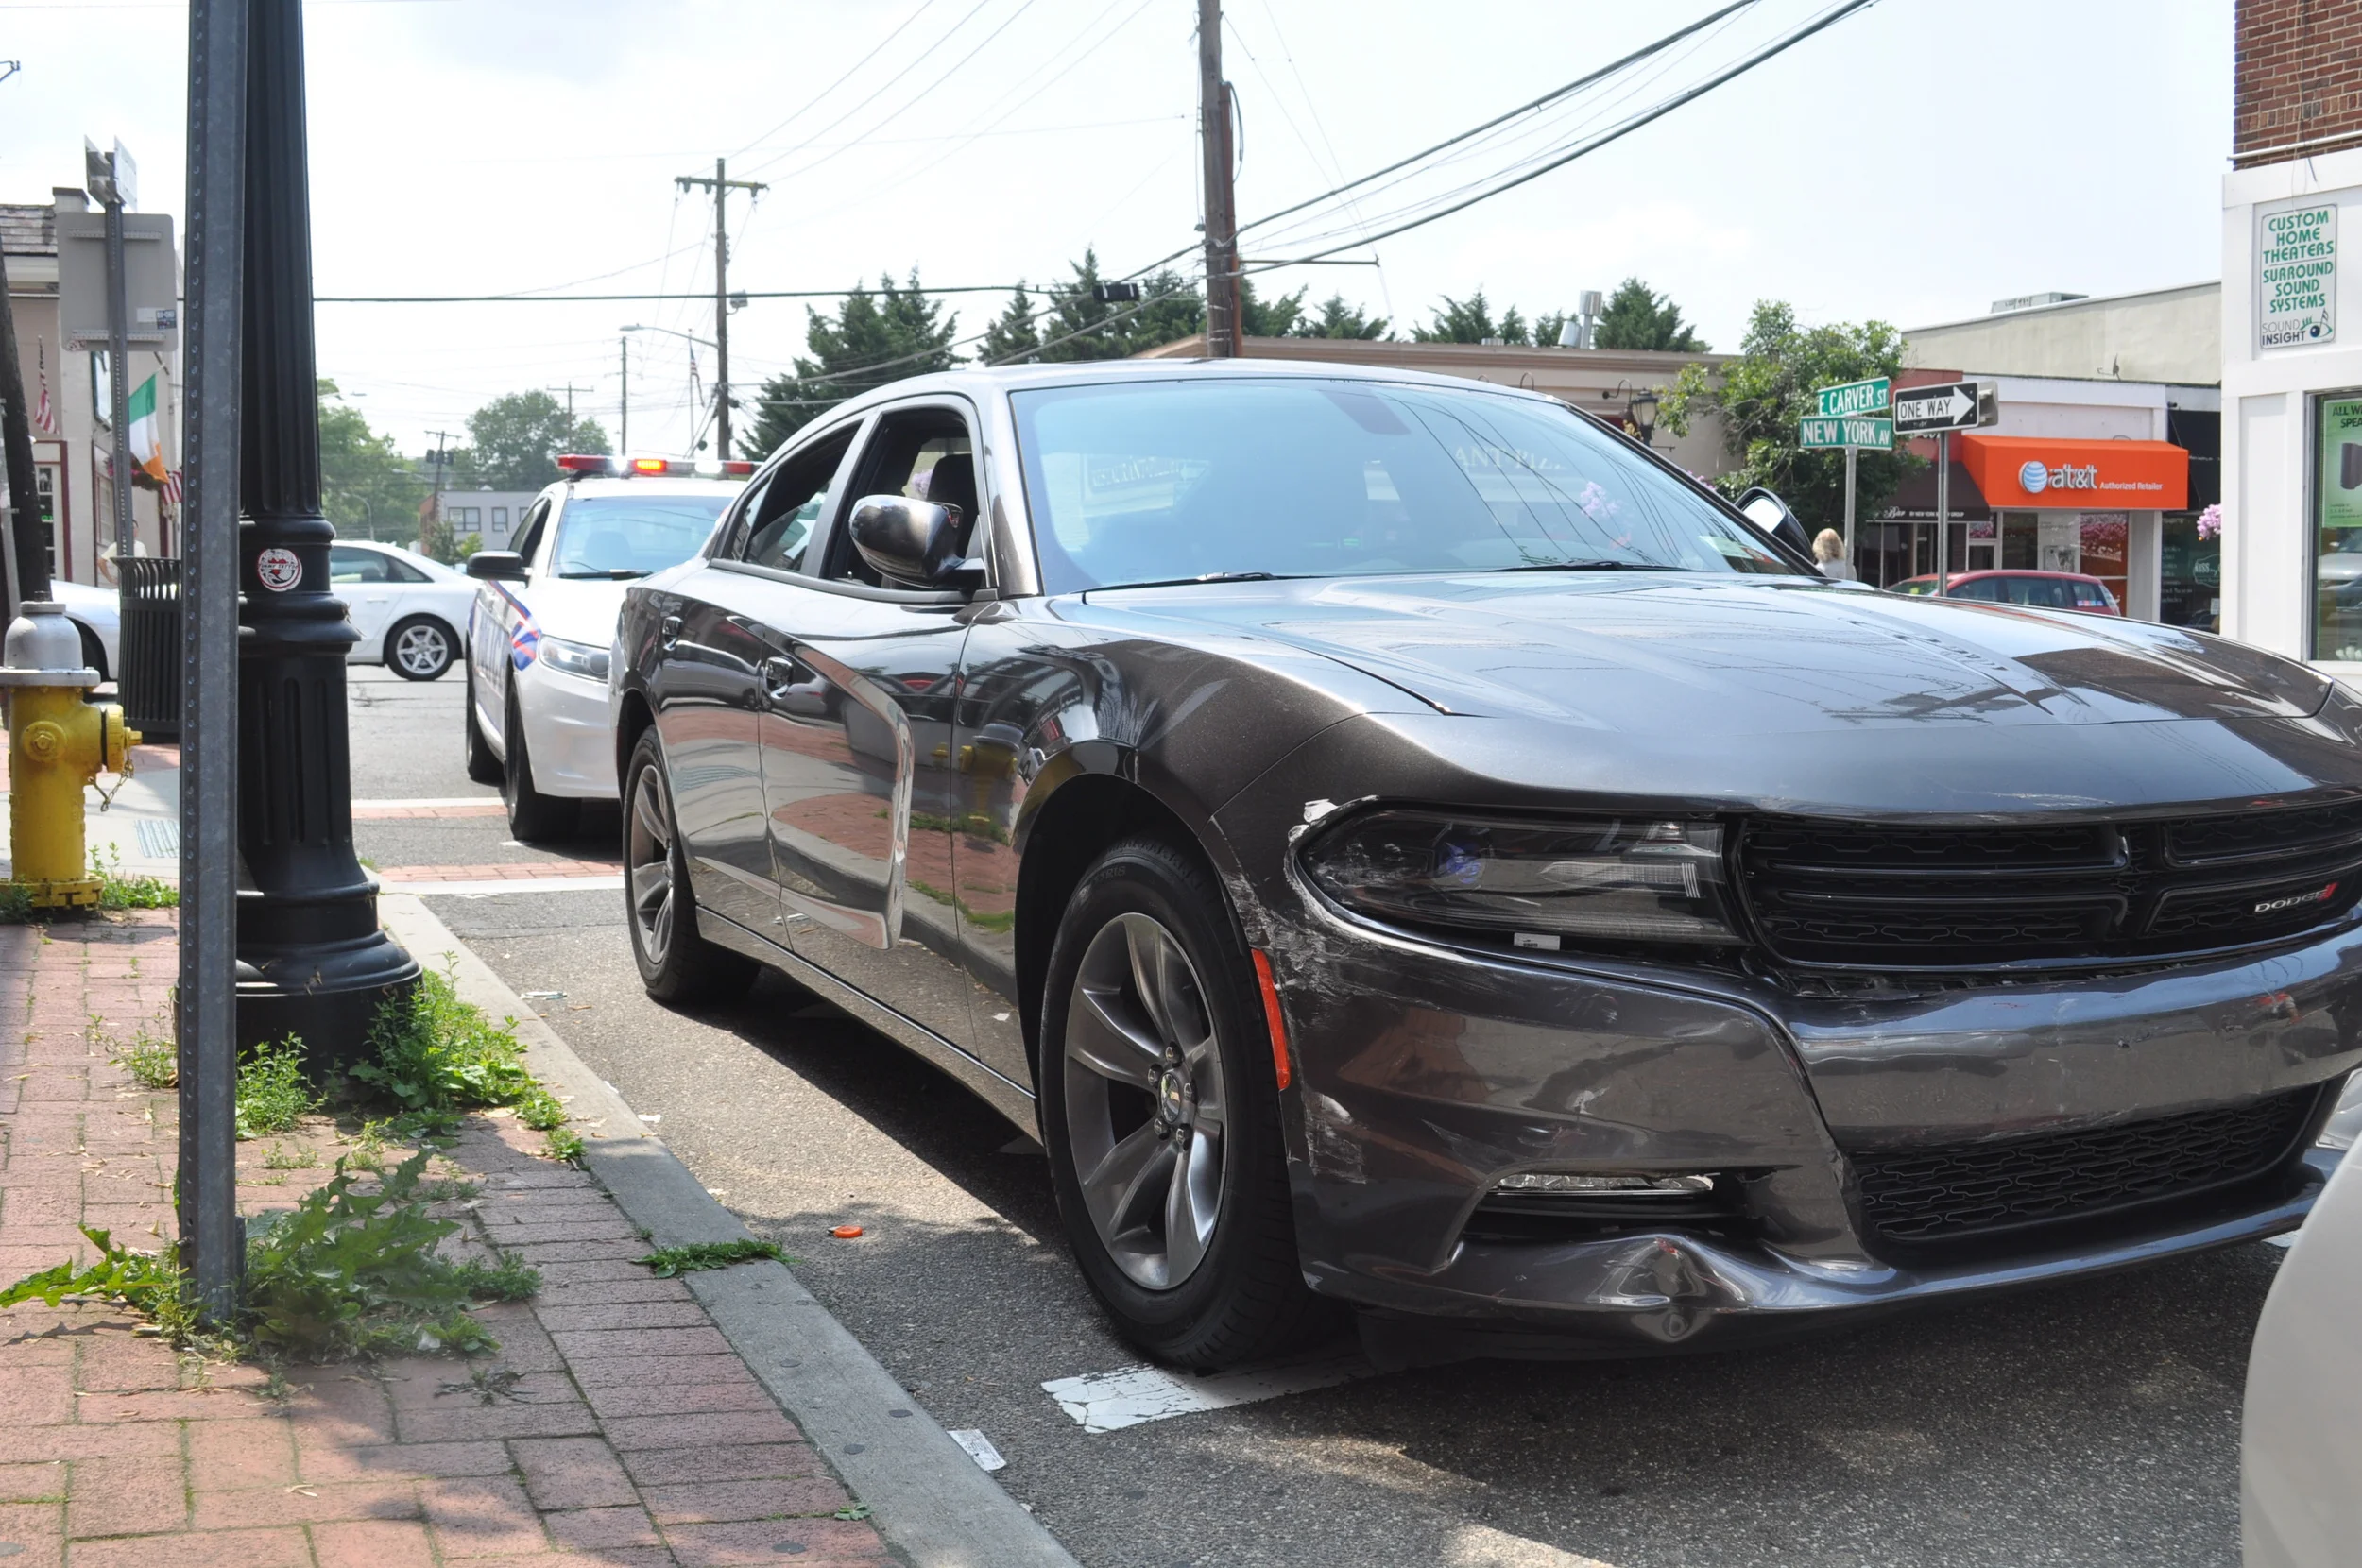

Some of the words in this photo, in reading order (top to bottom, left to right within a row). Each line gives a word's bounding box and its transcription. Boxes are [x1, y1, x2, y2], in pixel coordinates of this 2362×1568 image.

[2268, 210, 2329, 232] CUSTOM
[2276, 227, 2320, 247] HOME
[2263, 240, 2334, 264] THEATERS
[2263, 261, 2334, 283] SURROUND
[2275, 279, 2320, 298] SOUND
[2269, 293, 2326, 314] SYSTEMS
[2262, 318, 2301, 334] SOUND
[2262, 331, 2306, 346] INSIGHT
[1829, 384, 1874, 414] CARVER
[1876, 388, 1888, 406] ST
[1900, 401, 1922, 419] ONE
[1926, 399, 1951, 417] WAY
[1802, 420, 1838, 444] NEW
[1842, 421, 1876, 445] YORK
[1878, 429, 1890, 446] AV
[2049, 464, 2097, 489] at&t
[2099, 482, 2136, 490] Authorized
[2137, 482, 2163, 490] Retailer
[2254, 889, 2328, 912] DODGE
